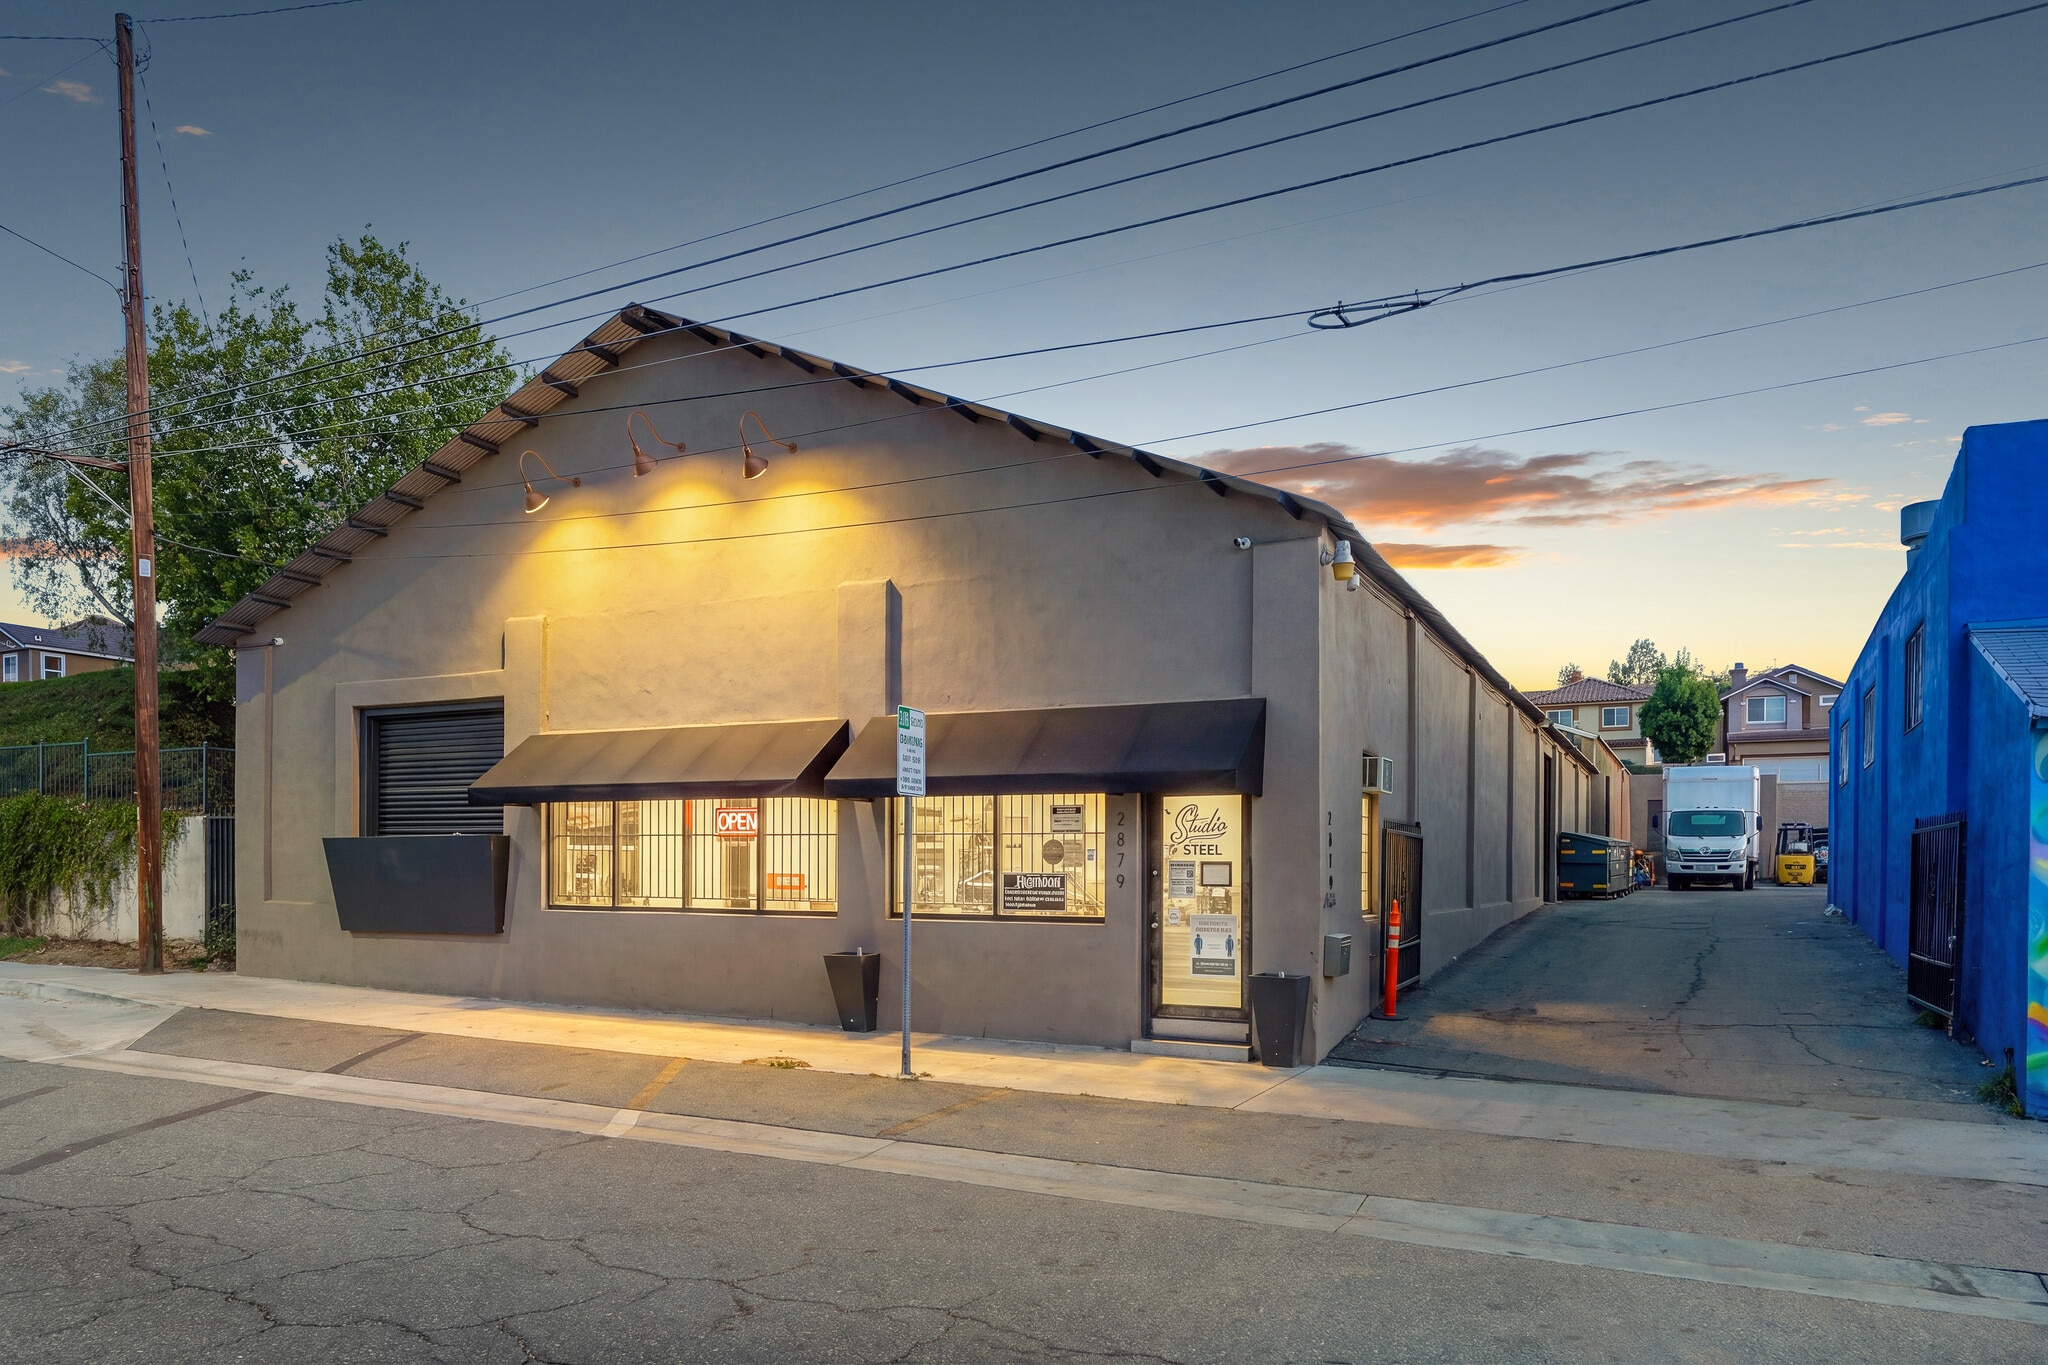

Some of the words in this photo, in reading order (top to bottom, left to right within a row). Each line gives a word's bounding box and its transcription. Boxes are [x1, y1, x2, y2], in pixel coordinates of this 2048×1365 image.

[717, 812, 758, 831] OPEN
[1170, 803, 1228, 846] Studio
[1116, 811, 1125, 889] 2879
[1183, 844, 1223, 856] STEEL
